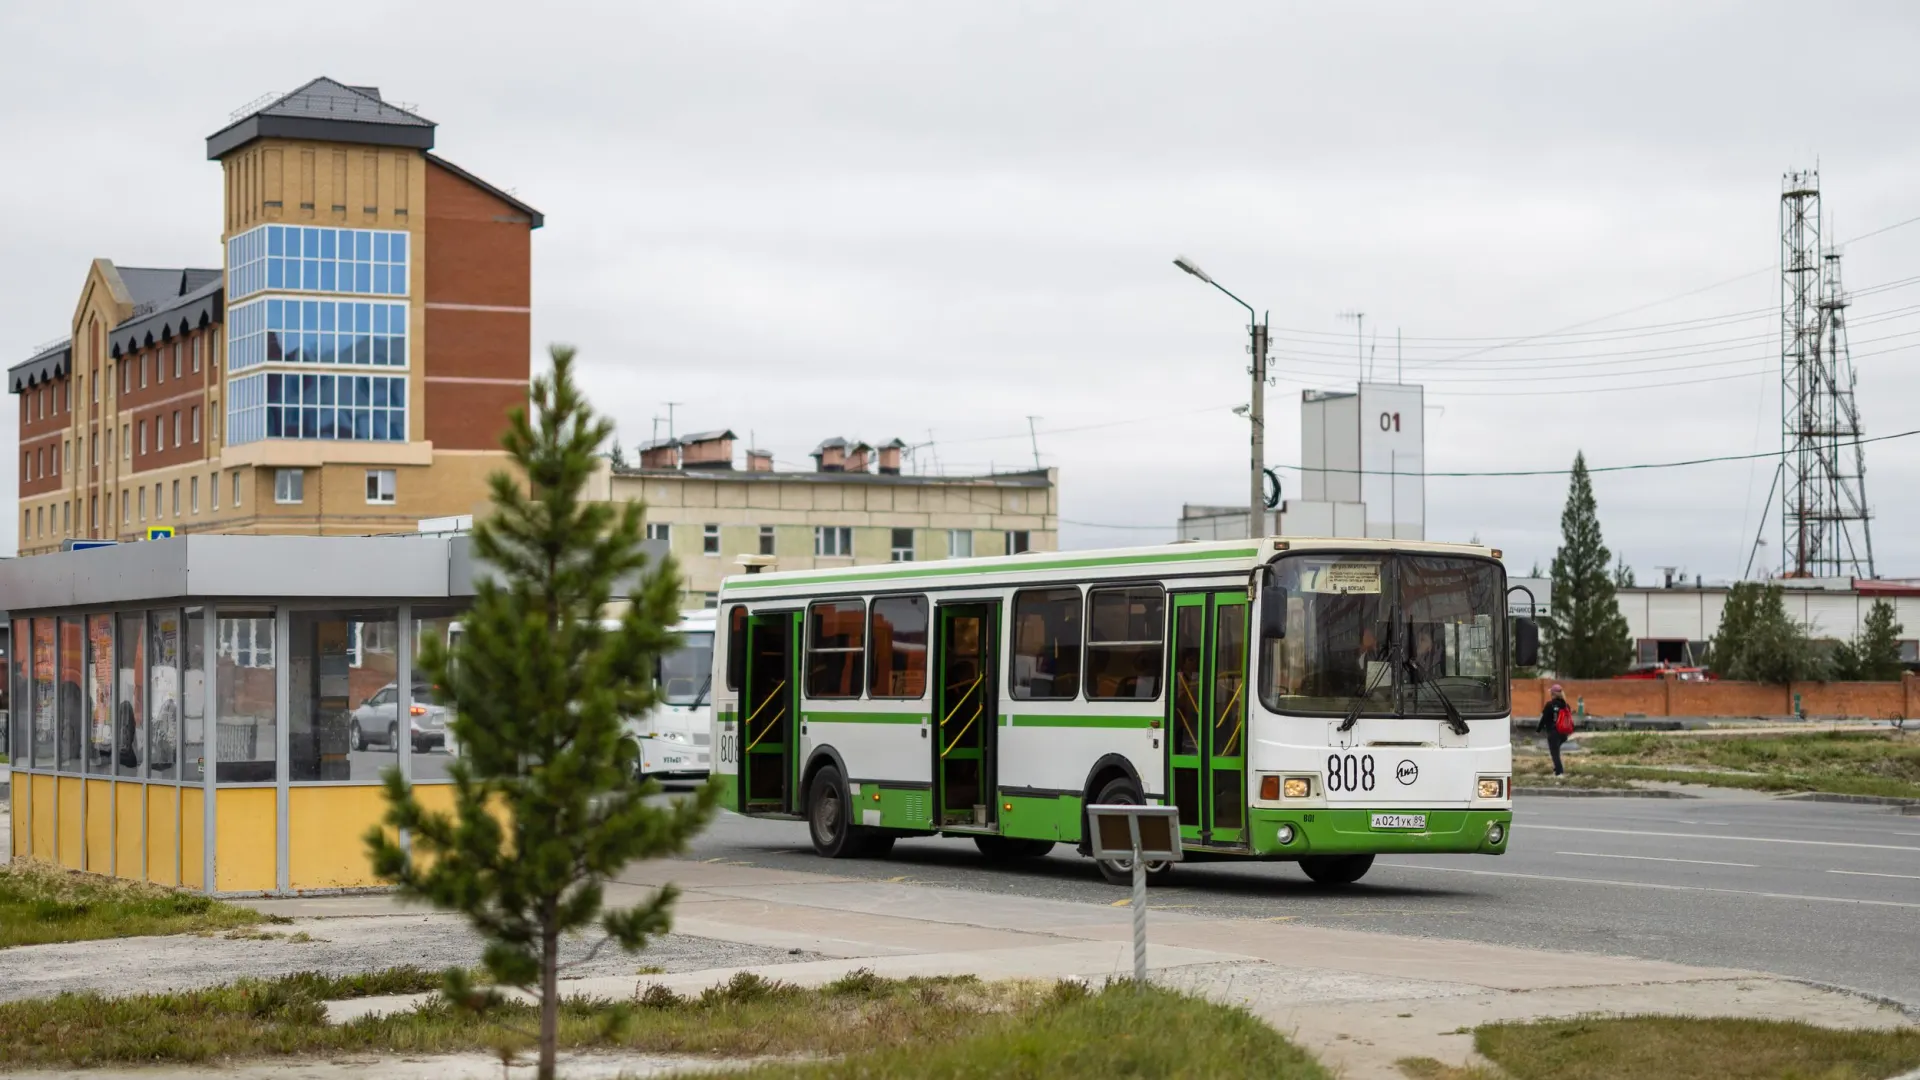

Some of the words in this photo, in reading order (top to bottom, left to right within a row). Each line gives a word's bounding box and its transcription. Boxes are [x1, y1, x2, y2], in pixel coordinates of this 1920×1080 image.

[1380, 412, 1400, 432] 01
[1307, 566, 1321, 589] 7
[1508, 606, 1532, 614] ДЧИКО
[1327, 754, 1375, 791] 808
